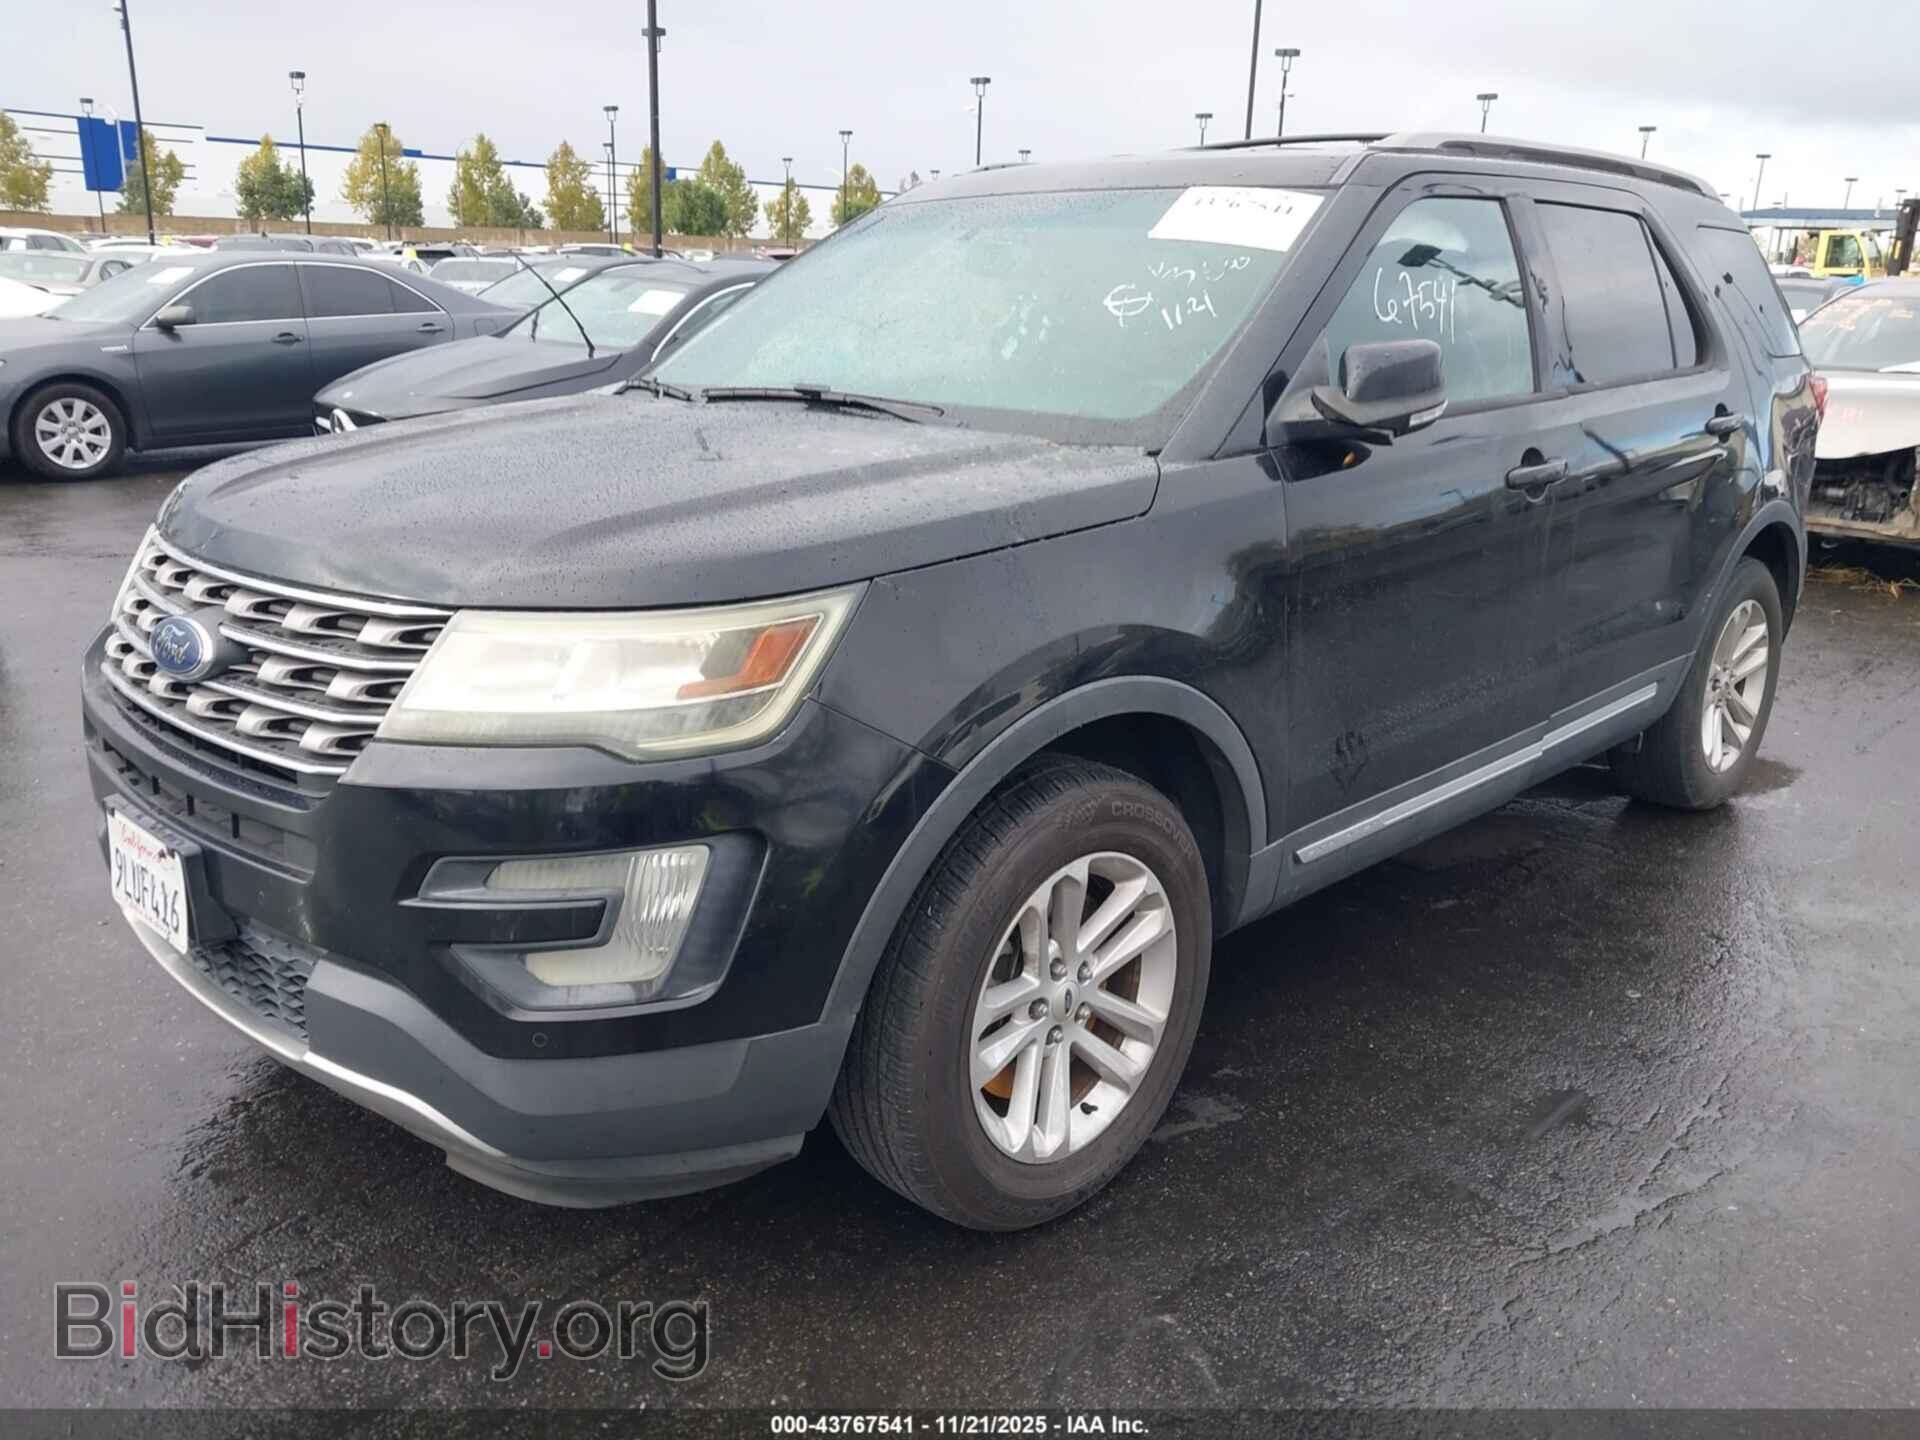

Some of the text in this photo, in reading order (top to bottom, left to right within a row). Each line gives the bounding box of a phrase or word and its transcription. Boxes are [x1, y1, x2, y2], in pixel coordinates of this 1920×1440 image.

[1373, 266, 1457, 345] 67541
[1110, 799, 1204, 859] CROSSOVER
[115, 847, 180, 934] 9LUF416
